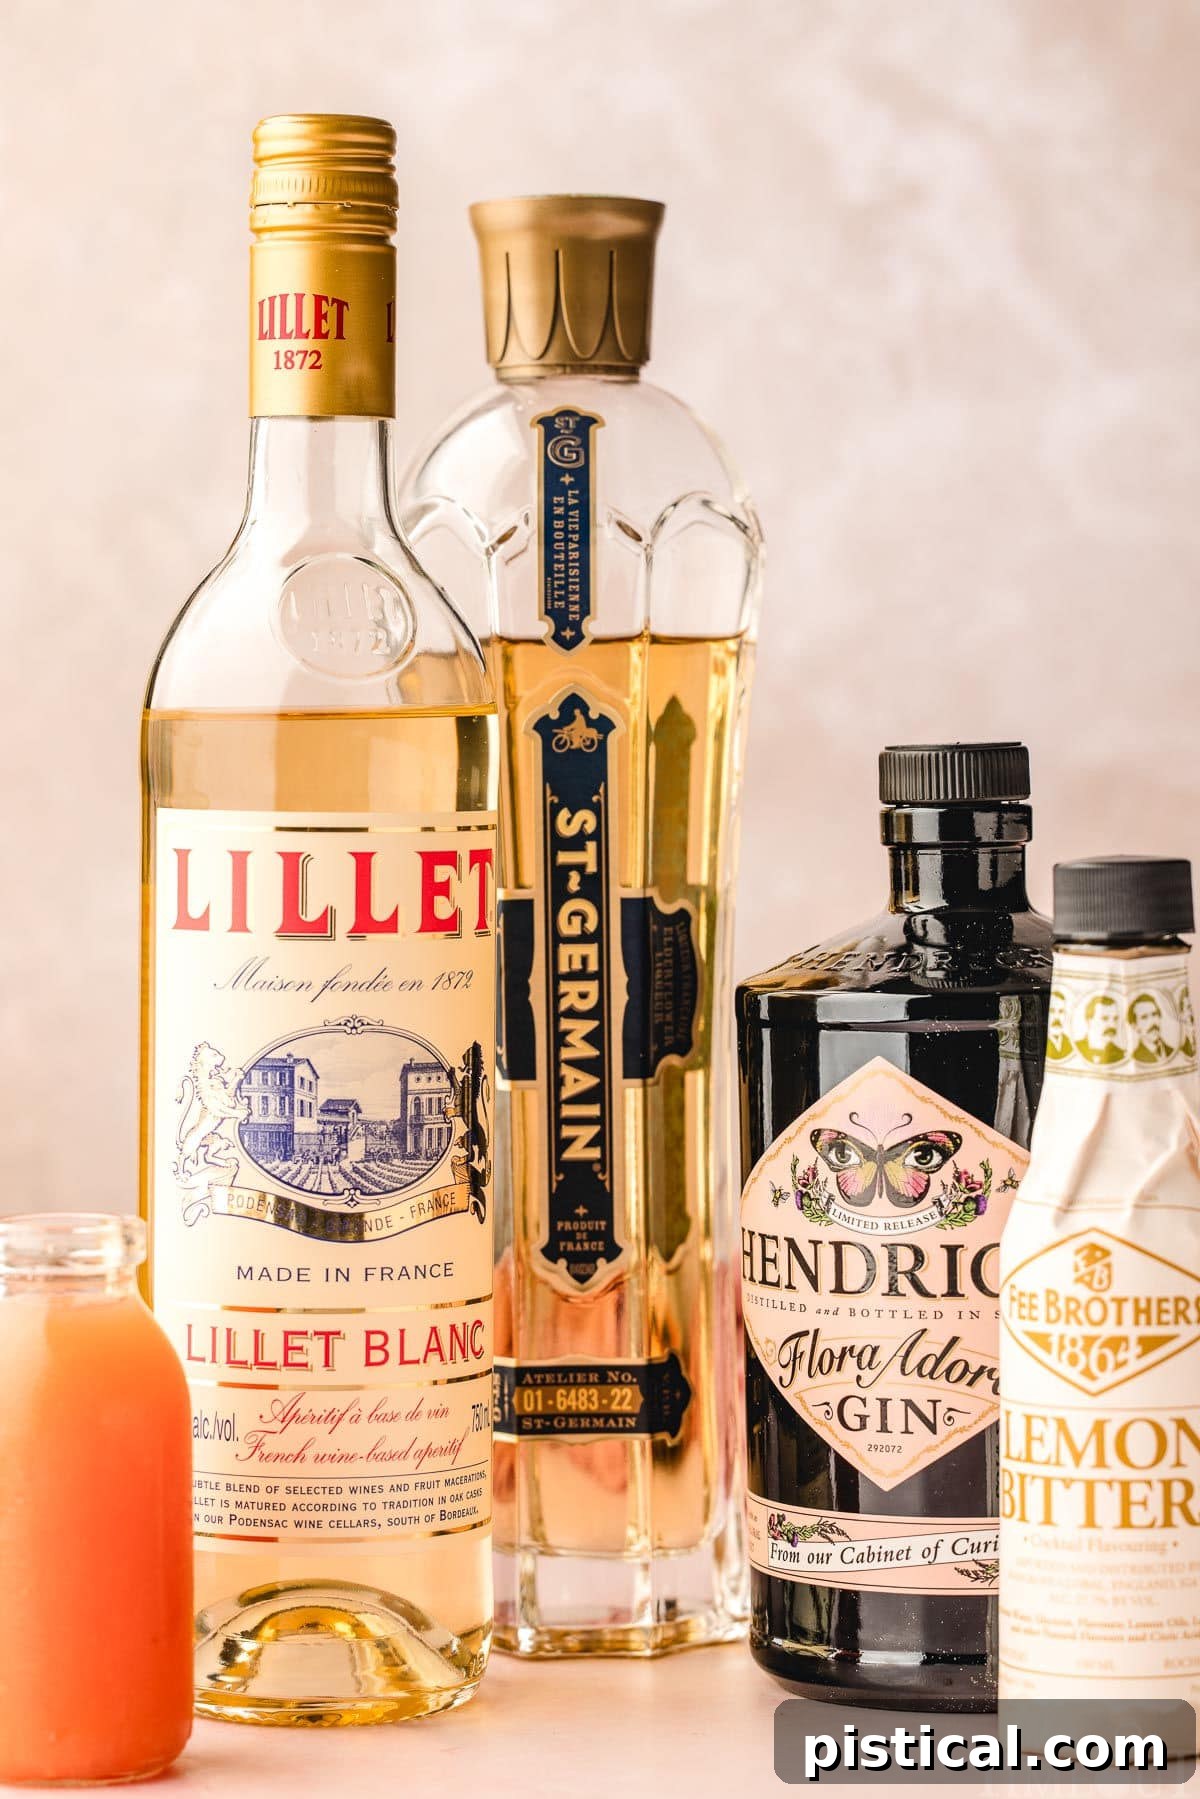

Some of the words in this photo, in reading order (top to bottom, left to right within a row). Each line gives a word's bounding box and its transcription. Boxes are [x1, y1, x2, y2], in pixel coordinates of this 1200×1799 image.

[258, 293, 349, 340] LILLET
[274, 350, 322, 370] 1872
[553, 496, 565, 514] EN
[568, 490, 580, 506] LA
[568, 510, 580, 531] VIE
[553, 521, 565, 609] BOUTEILLE
[568, 534, 580, 621] PARISIENNE
[172, 848, 493, 940] LILLET
[214, 956, 313, 992] Maison
[311, 964, 392, 1003] fondée
[399, 979, 424, 992] en
[431, 969, 474, 992] 1872
[409, 1192, 457, 1219] FRANCE
[557, 1221, 606, 1231] PRODUIT
[830, 1208, 879, 1231] LIMITED
[883, 1210, 938, 1231] RELEASE
[236, 1266, 311, 1283] MADE
[325, 1267, 351, 1282] IN
[364, 1262, 454, 1282] FRANCE
[816, 1306, 841, 1317] and
[849, 1307, 944, 1321] BOTTLED
[957, 1309, 981, 1320] IN
[1009, 1284, 1038, 1321] FEE
[185, 1322, 346, 1372] LILLET
[363, 1319, 486, 1367] BLANC
[778, 1328, 881, 1389] Flora
[1050, 1334, 1143, 1379] 1864
[522, 1372, 600, 1385] ATELIER
[193, 1409, 239, 1442] alc./vol.
[260, 1391, 361, 1435] Apéritif
[368, 1397, 401, 1425] base
[405, 1397, 424, 1421] de
[428, 1403, 451, 1419] vin
[522, 1416, 637, 1430] ST-GERMAIN
[836, 1395, 942, 1435] GIN
[235, 1430, 316, 1464] French
[314, 1435, 418, 1464] wine-based
[413, 1426, 471, 1470] aperitif
[867, 1443, 903, 1454] 292072
[1003, 1410, 1200, 1471] LEMON
[225, 1482, 260, 1494] BLEND
[265, 1485, 280, 1495] OF
[285, 1486, 343, 1495] SELECTED
[349, 1485, 384, 1495] WINES
[389, 1483, 410, 1493] AND
[414, 1480, 441, 1492] FRUIT
[444, 1470, 487, 1488] MACERATIONS,
[220, 1499, 230, 1508] IS
[235, 1500, 286, 1512] MATURED
[291, 1503, 357, 1512] ACCORDING
[362, 1502, 377, 1512] TO
[382, 1498, 434, 1511] TRADITION
[438, 1497, 447, 1505] IN
[449, 1493, 464, 1503] OAK
[466, 1487, 483, 1500] CASKS
[1001, 1468, 1200, 1529] BITTER
[203, 1514, 224, 1525] OUR
[229, 1513, 289, 1529] PODENSAC
[294, 1519, 323, 1529] WINE
[328, 1519, 382, 1530] CELLARS,
[387, 1516, 420, 1527] SOUTH
[424, 1514, 437, 1523] OF
[770, 1542, 801, 1564] From
[807, 1552, 832, 1565] our
[840, 1546, 912, 1565] Cabinet
[921, 1539, 944, 1564] of
